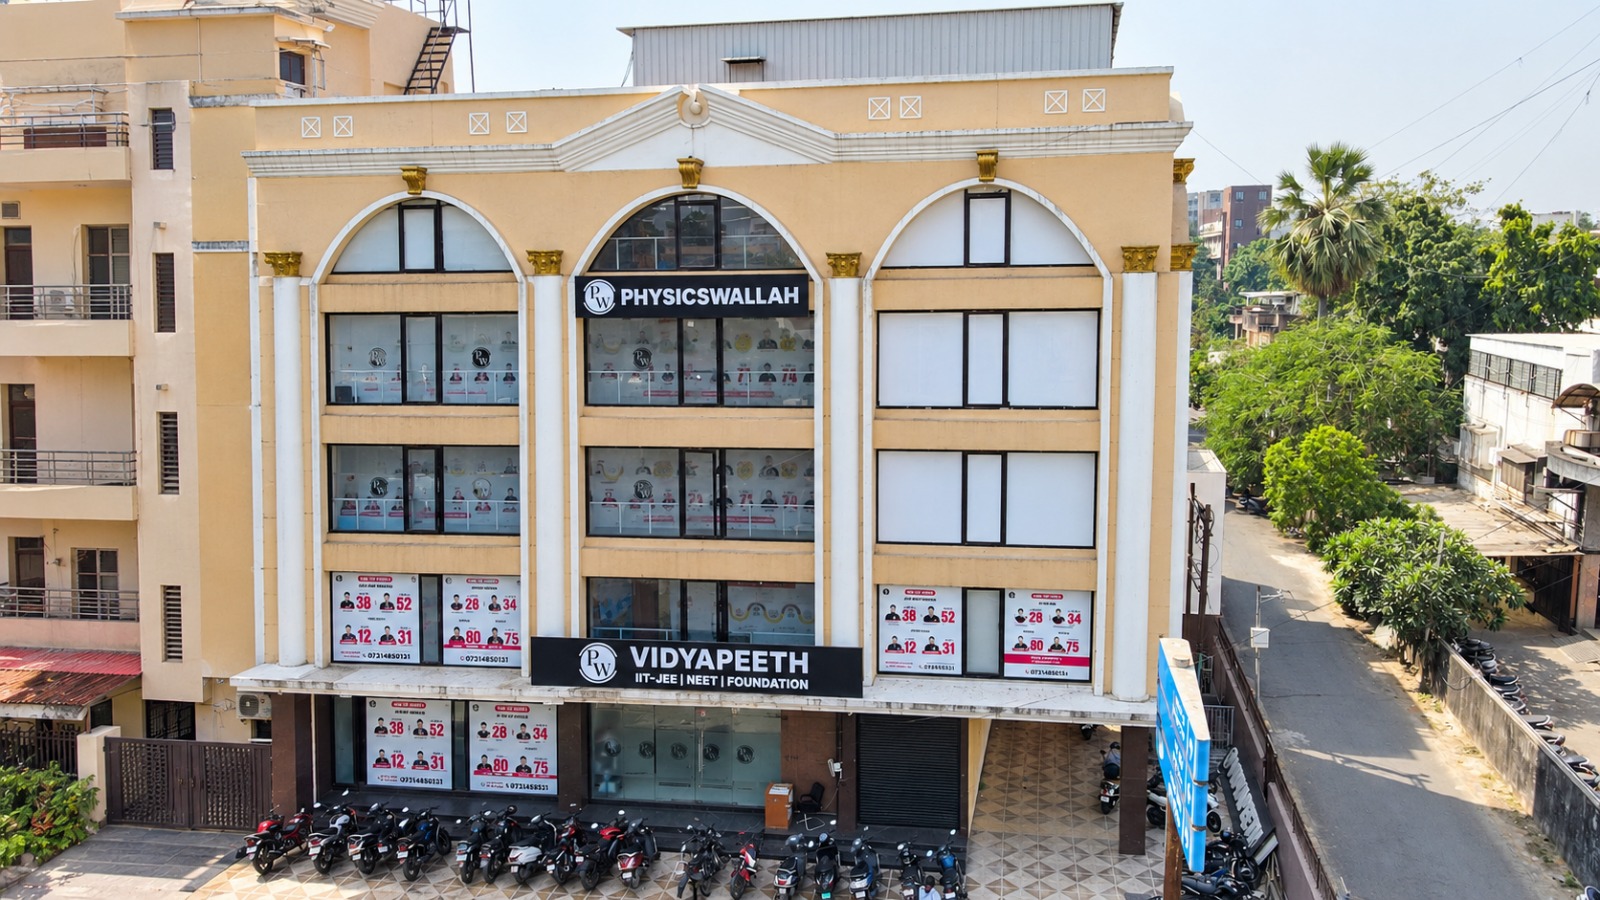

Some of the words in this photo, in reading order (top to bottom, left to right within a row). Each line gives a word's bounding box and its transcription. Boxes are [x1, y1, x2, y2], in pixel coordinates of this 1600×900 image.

[621, 287, 799, 306] PHYSICSWALLAH
[356, 596, 371, 610] 38
[396, 597, 412, 610] 52
[465, 598, 479, 610] 28
[503, 599, 517, 611] 34
[902, 609, 916, 622] 38
[941, 610, 955, 623] 52
[1029, 612, 1043, 623] 28
[1067, 613, 1081, 624] 34
[357, 629, 371, 643] 12
[398, 630, 411, 644] 31
[466, 630, 481, 643] 80
[504, 632, 519, 645] 75
[904, 641, 917, 654] 12
[942, 642, 955, 655] 31
[1030, 640, 1044, 651] 80
[1066, 641, 1079, 653] 75
[630, 645, 809, 674] VIDYAPEETH
[635, 672, 678, 685] IIT-JEE
[686, 675, 719, 687] NEET
[727, 677, 809, 690] FOUNDATION
[389, 721, 404, 735] 38
[430, 723, 444, 736] 52
[492, 725, 507, 738] 28
[533, 727, 548, 740] 34
[391, 753, 405, 769] 12
[430, 755, 444, 770] 31
[493, 758, 508, 772] 80
[533, 760, 549, 774] 75
